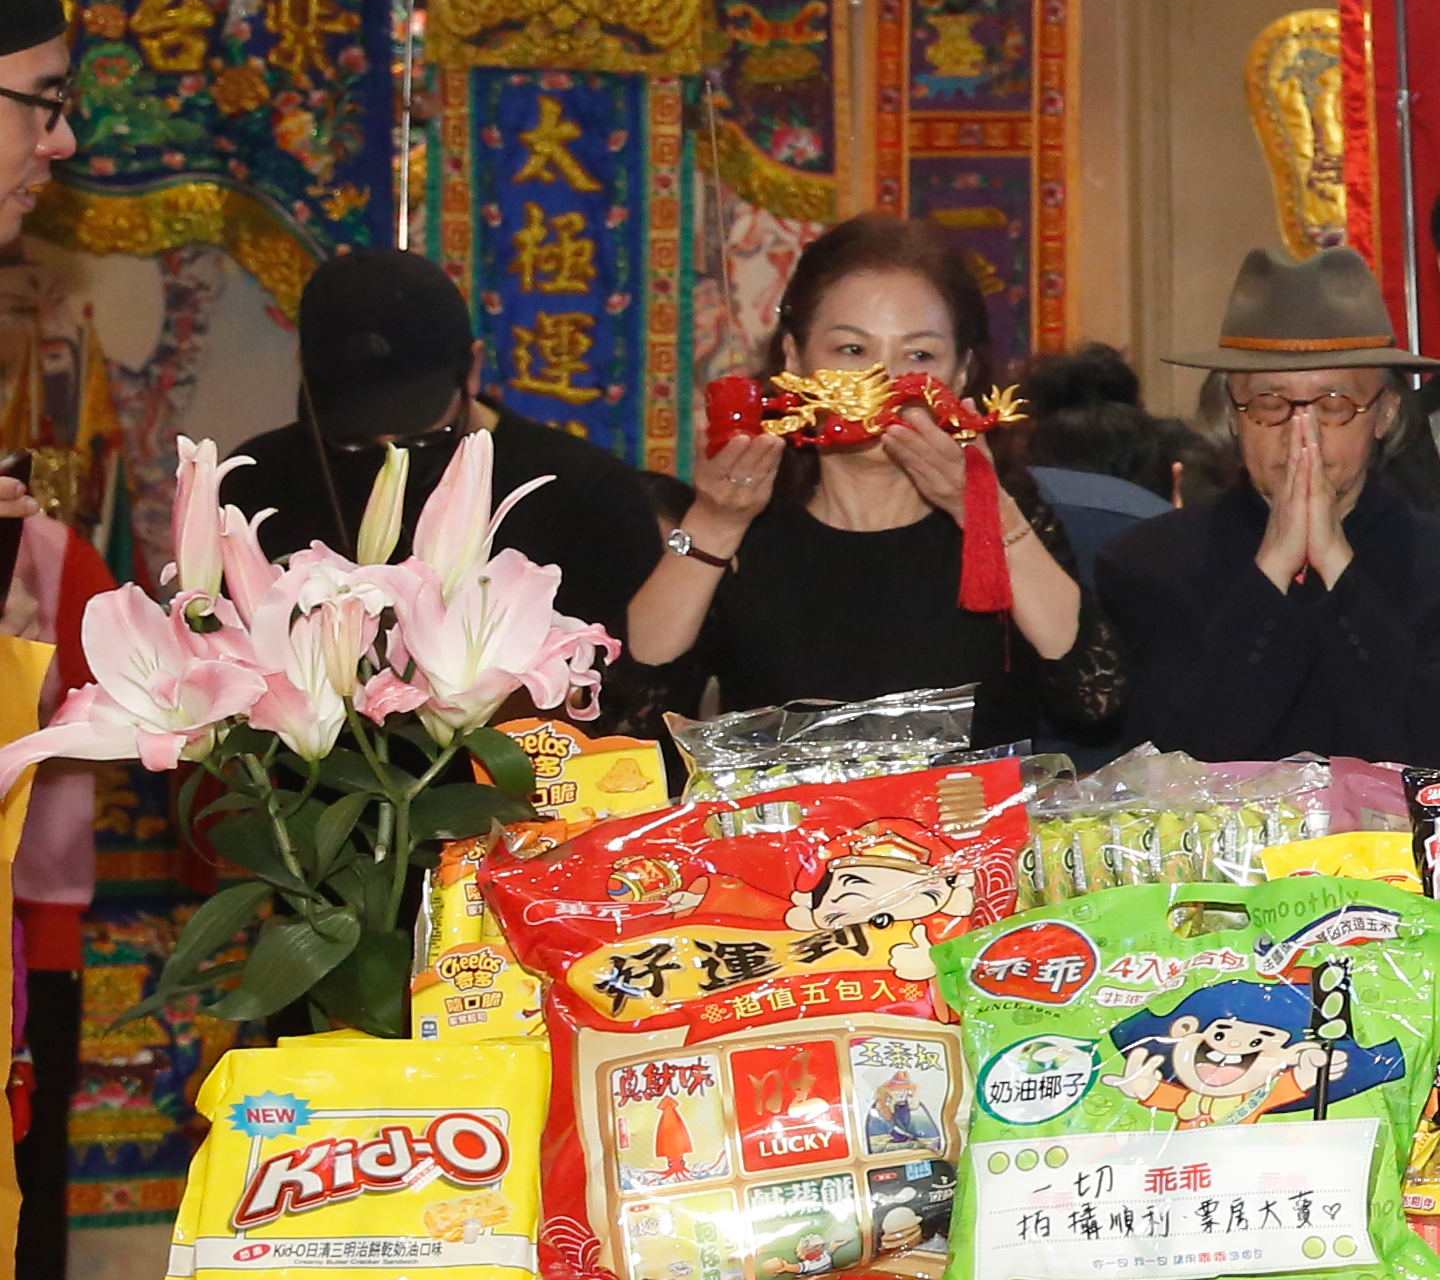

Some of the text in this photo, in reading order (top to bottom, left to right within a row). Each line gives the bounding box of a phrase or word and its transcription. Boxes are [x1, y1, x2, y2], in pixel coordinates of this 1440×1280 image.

[511, 94, 602, 438] 太極運
[516, 728, 571, 757] eetos
[440, 949, 503, 979] Cheetos
[732, 975, 900, 1021] 超值五包入
[988, 1072, 1087, 1105] 奶油椰子
[246, 1107, 296, 1124] NEW
[759, 1131, 833, 1158] LUCKY
[236, 1113, 507, 1222] Kid-O
[1032, 1162, 1213, 1199] 一切 乖乖
